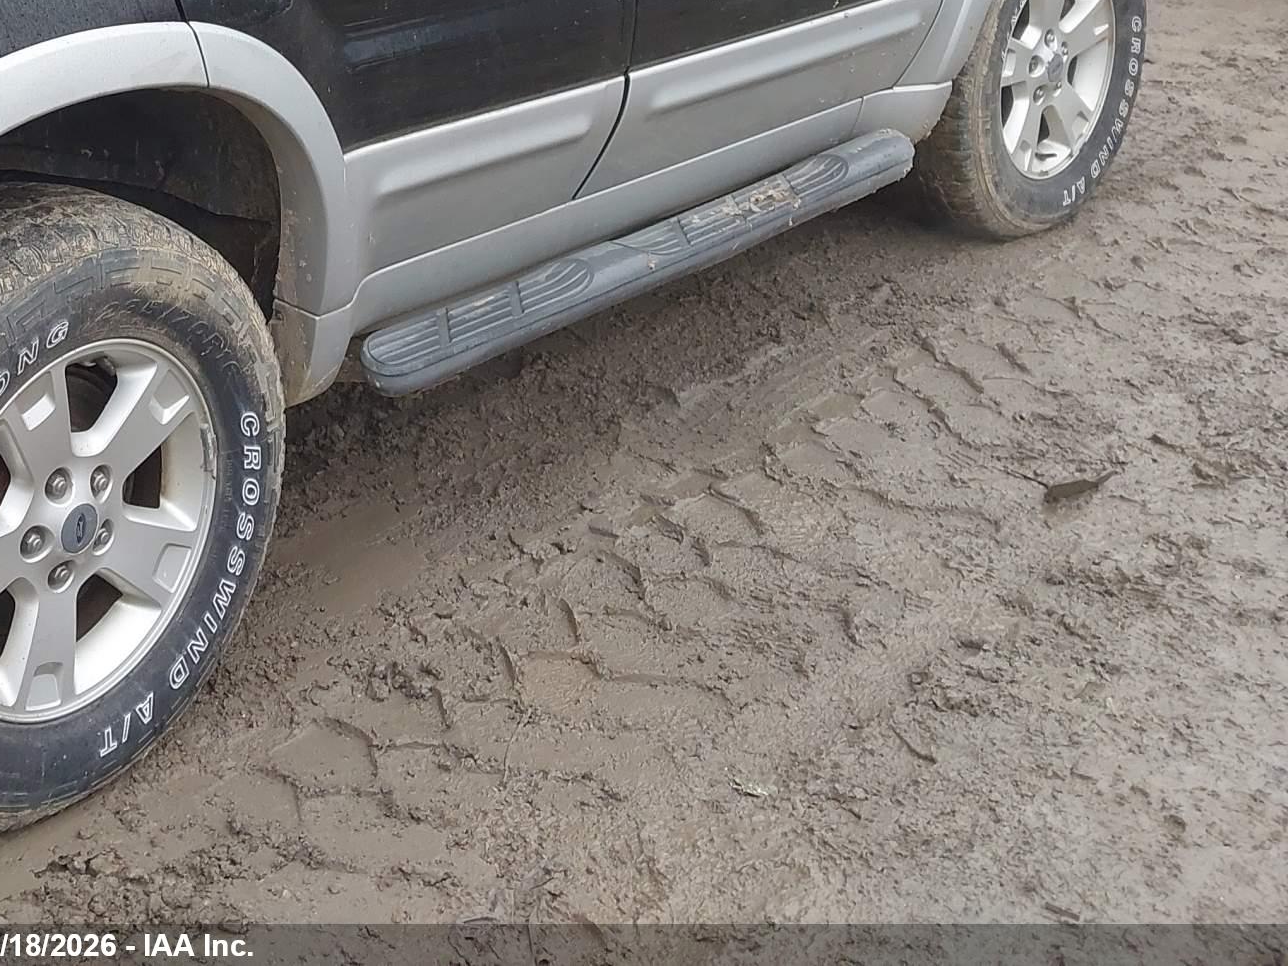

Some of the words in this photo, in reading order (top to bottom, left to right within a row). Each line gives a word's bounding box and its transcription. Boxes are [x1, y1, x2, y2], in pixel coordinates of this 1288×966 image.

[1090, 16, 1142, 177] CROSSWIND
[1062, 176, 1086, 206] A/T
[170, 410, 262, 690] CROSSWIND
[99, 689, 156, 758] A/T
